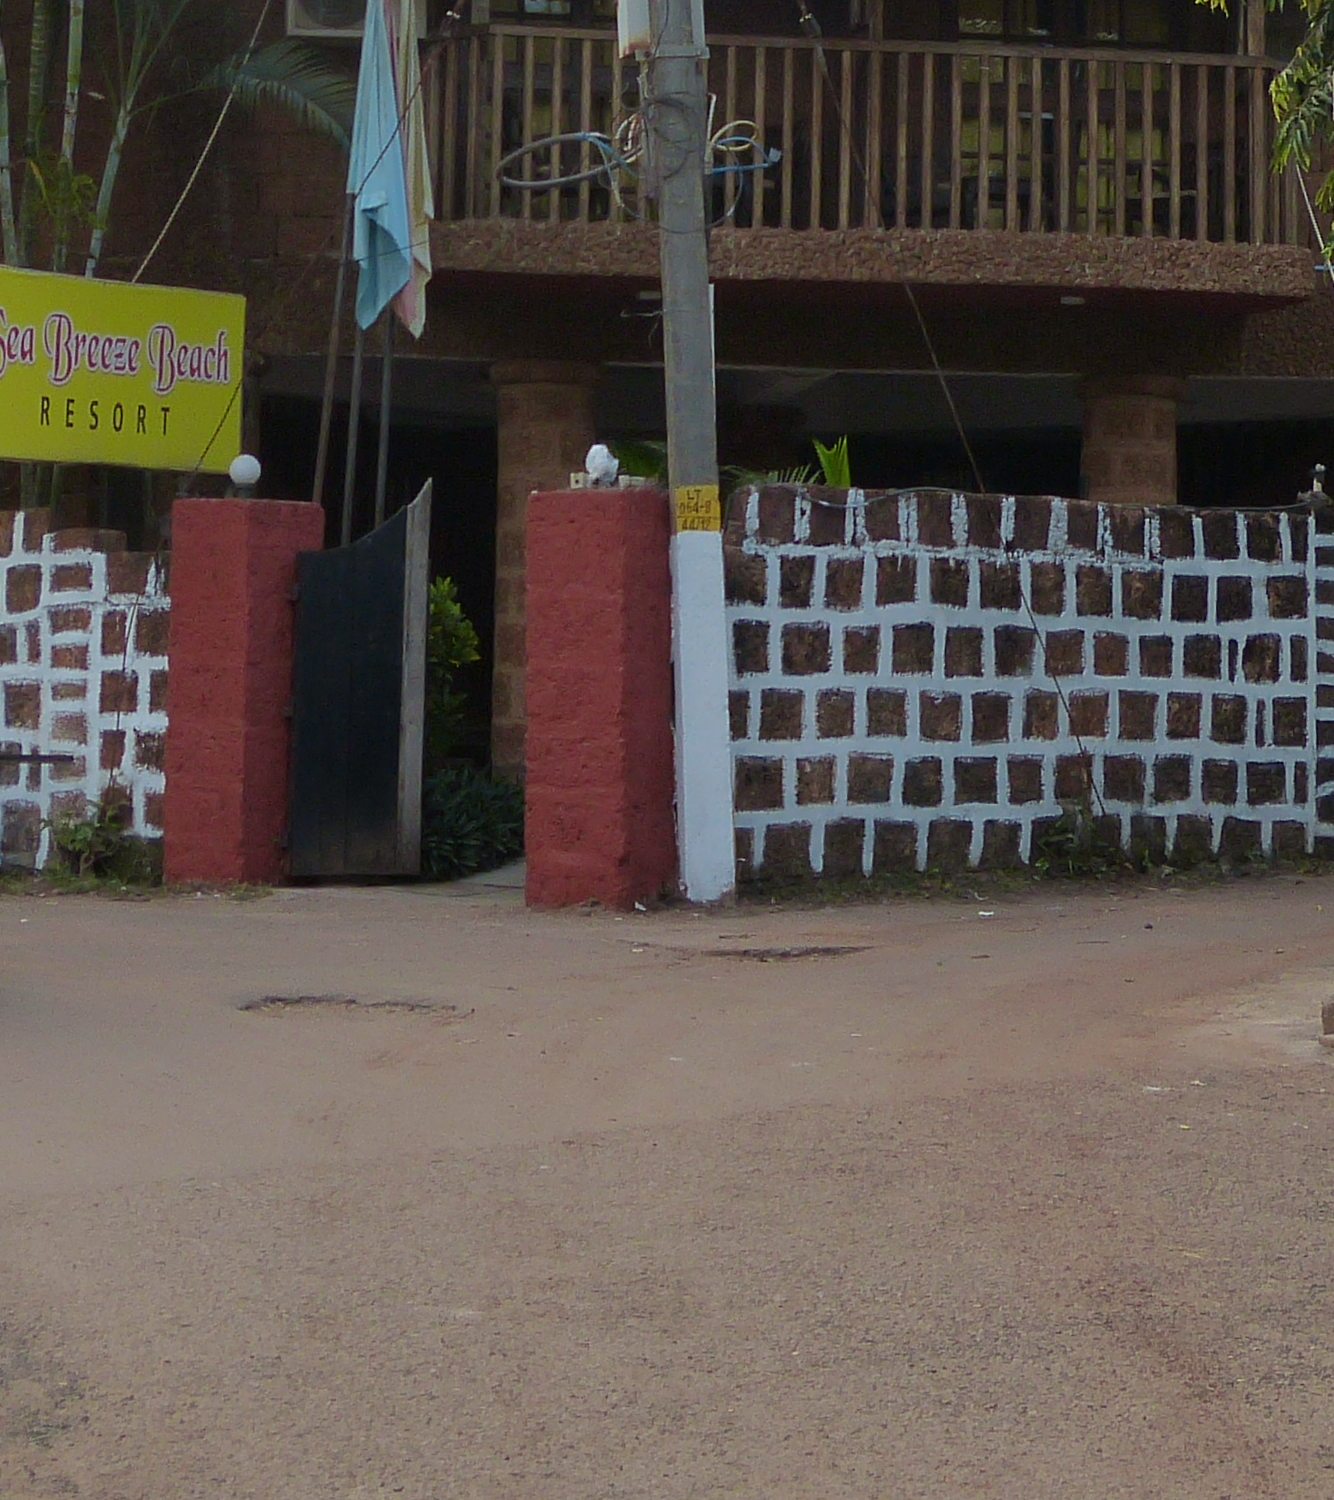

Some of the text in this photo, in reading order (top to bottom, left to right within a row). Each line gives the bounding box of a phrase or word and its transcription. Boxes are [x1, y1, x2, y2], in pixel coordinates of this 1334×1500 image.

[43, 312, 142, 386] Breeze
[148, 323, 231, 395] Beach
[40, 396, 170, 435] RESORT
[686, 489, 703, 500] LT
